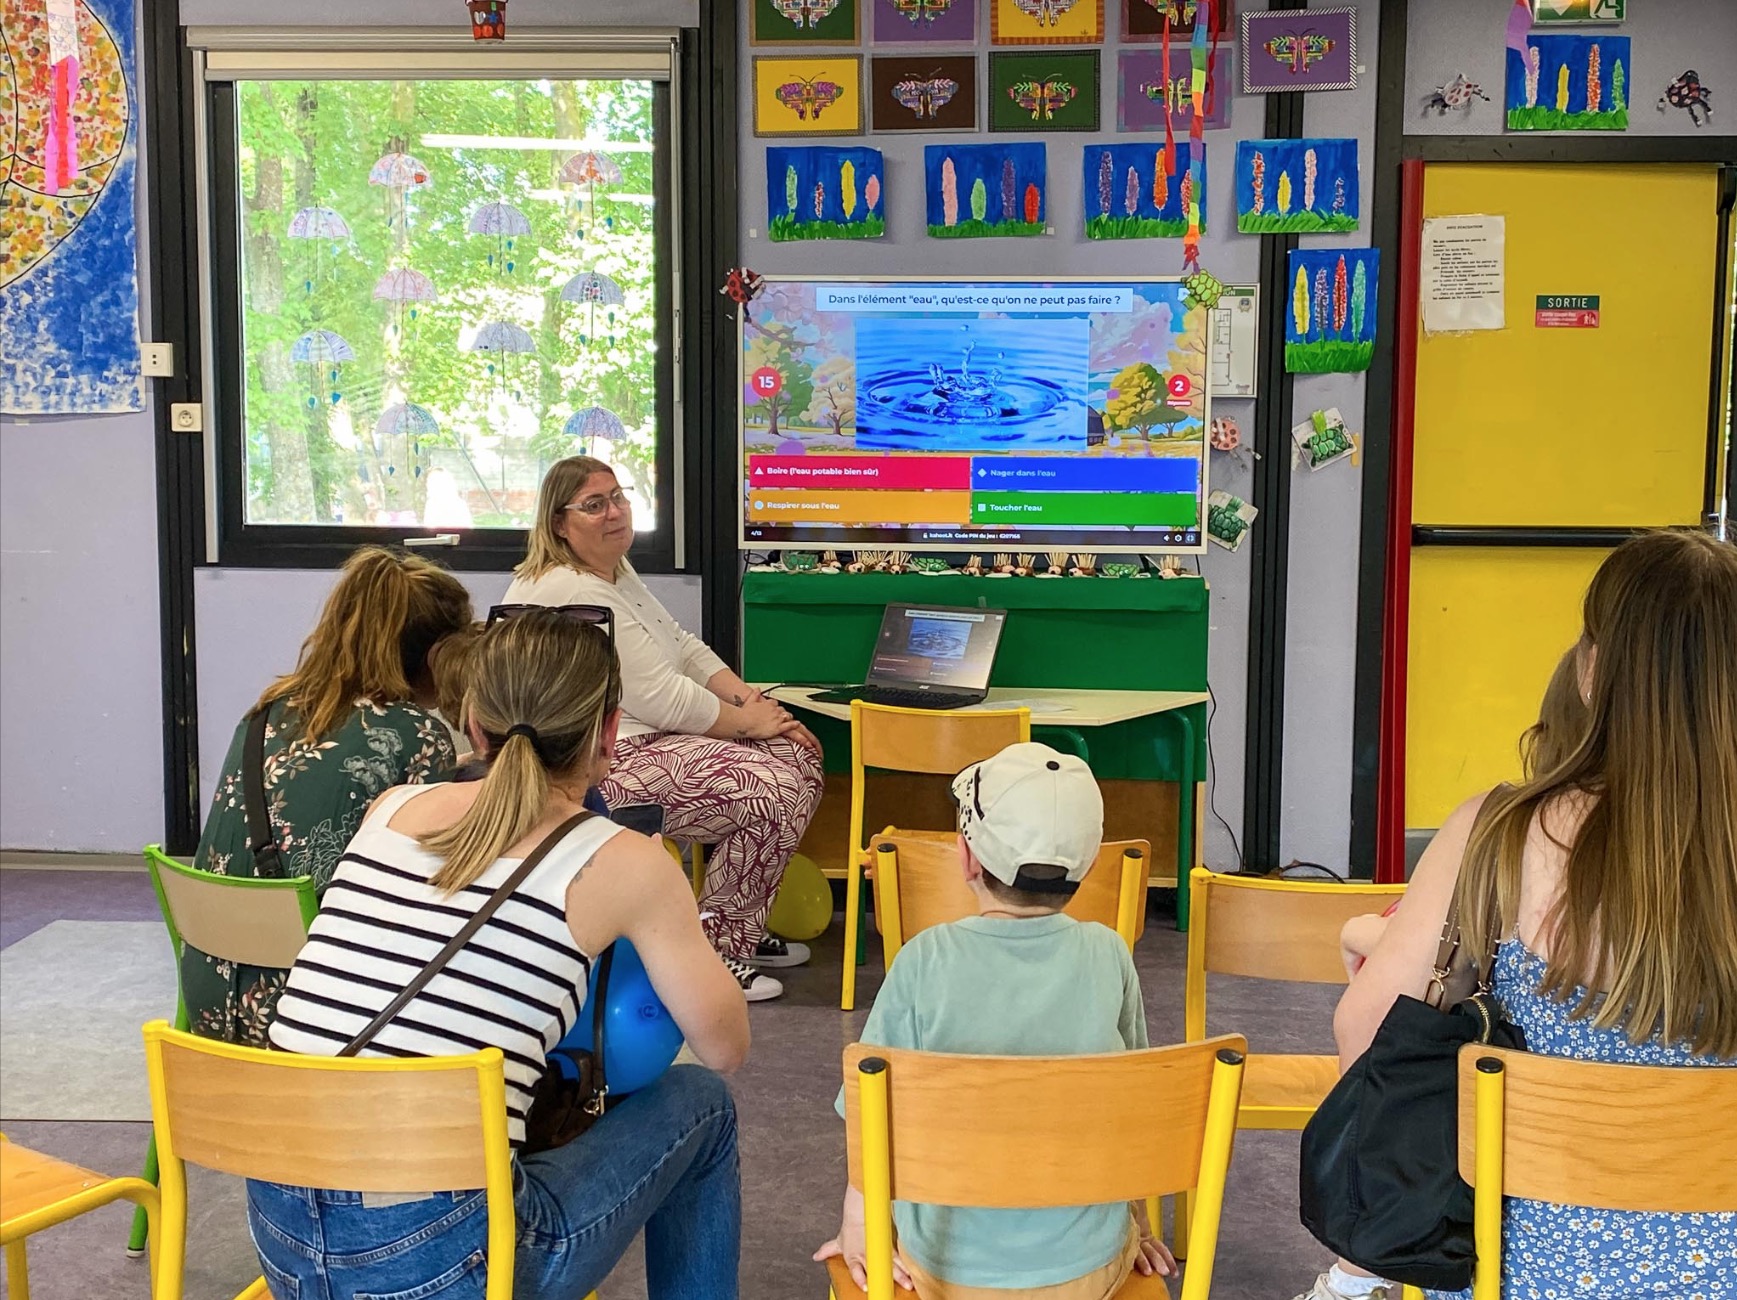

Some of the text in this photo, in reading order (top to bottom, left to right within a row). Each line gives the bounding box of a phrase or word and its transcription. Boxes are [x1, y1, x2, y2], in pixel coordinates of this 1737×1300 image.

[828, 294, 1121, 306] Dans l'élément "eau", qu'est-ce qu'on ne peut pas faire ?
[1547, 297, 1588, 308] SORTIE
[758, 376, 774, 389] 15
[1174, 380, 1184, 392] 2
[767, 467, 788, 475] Boire
[812, 467, 842, 476] potable
[843, 467, 862, 475] bien
[863, 467, 879, 476] sûr)
[990, 469, 1057, 478] Nager dans l'eau
[767, 502, 840, 510] Respirer sous l'eau
[990, 504, 1043, 512] Toucher l'eau
